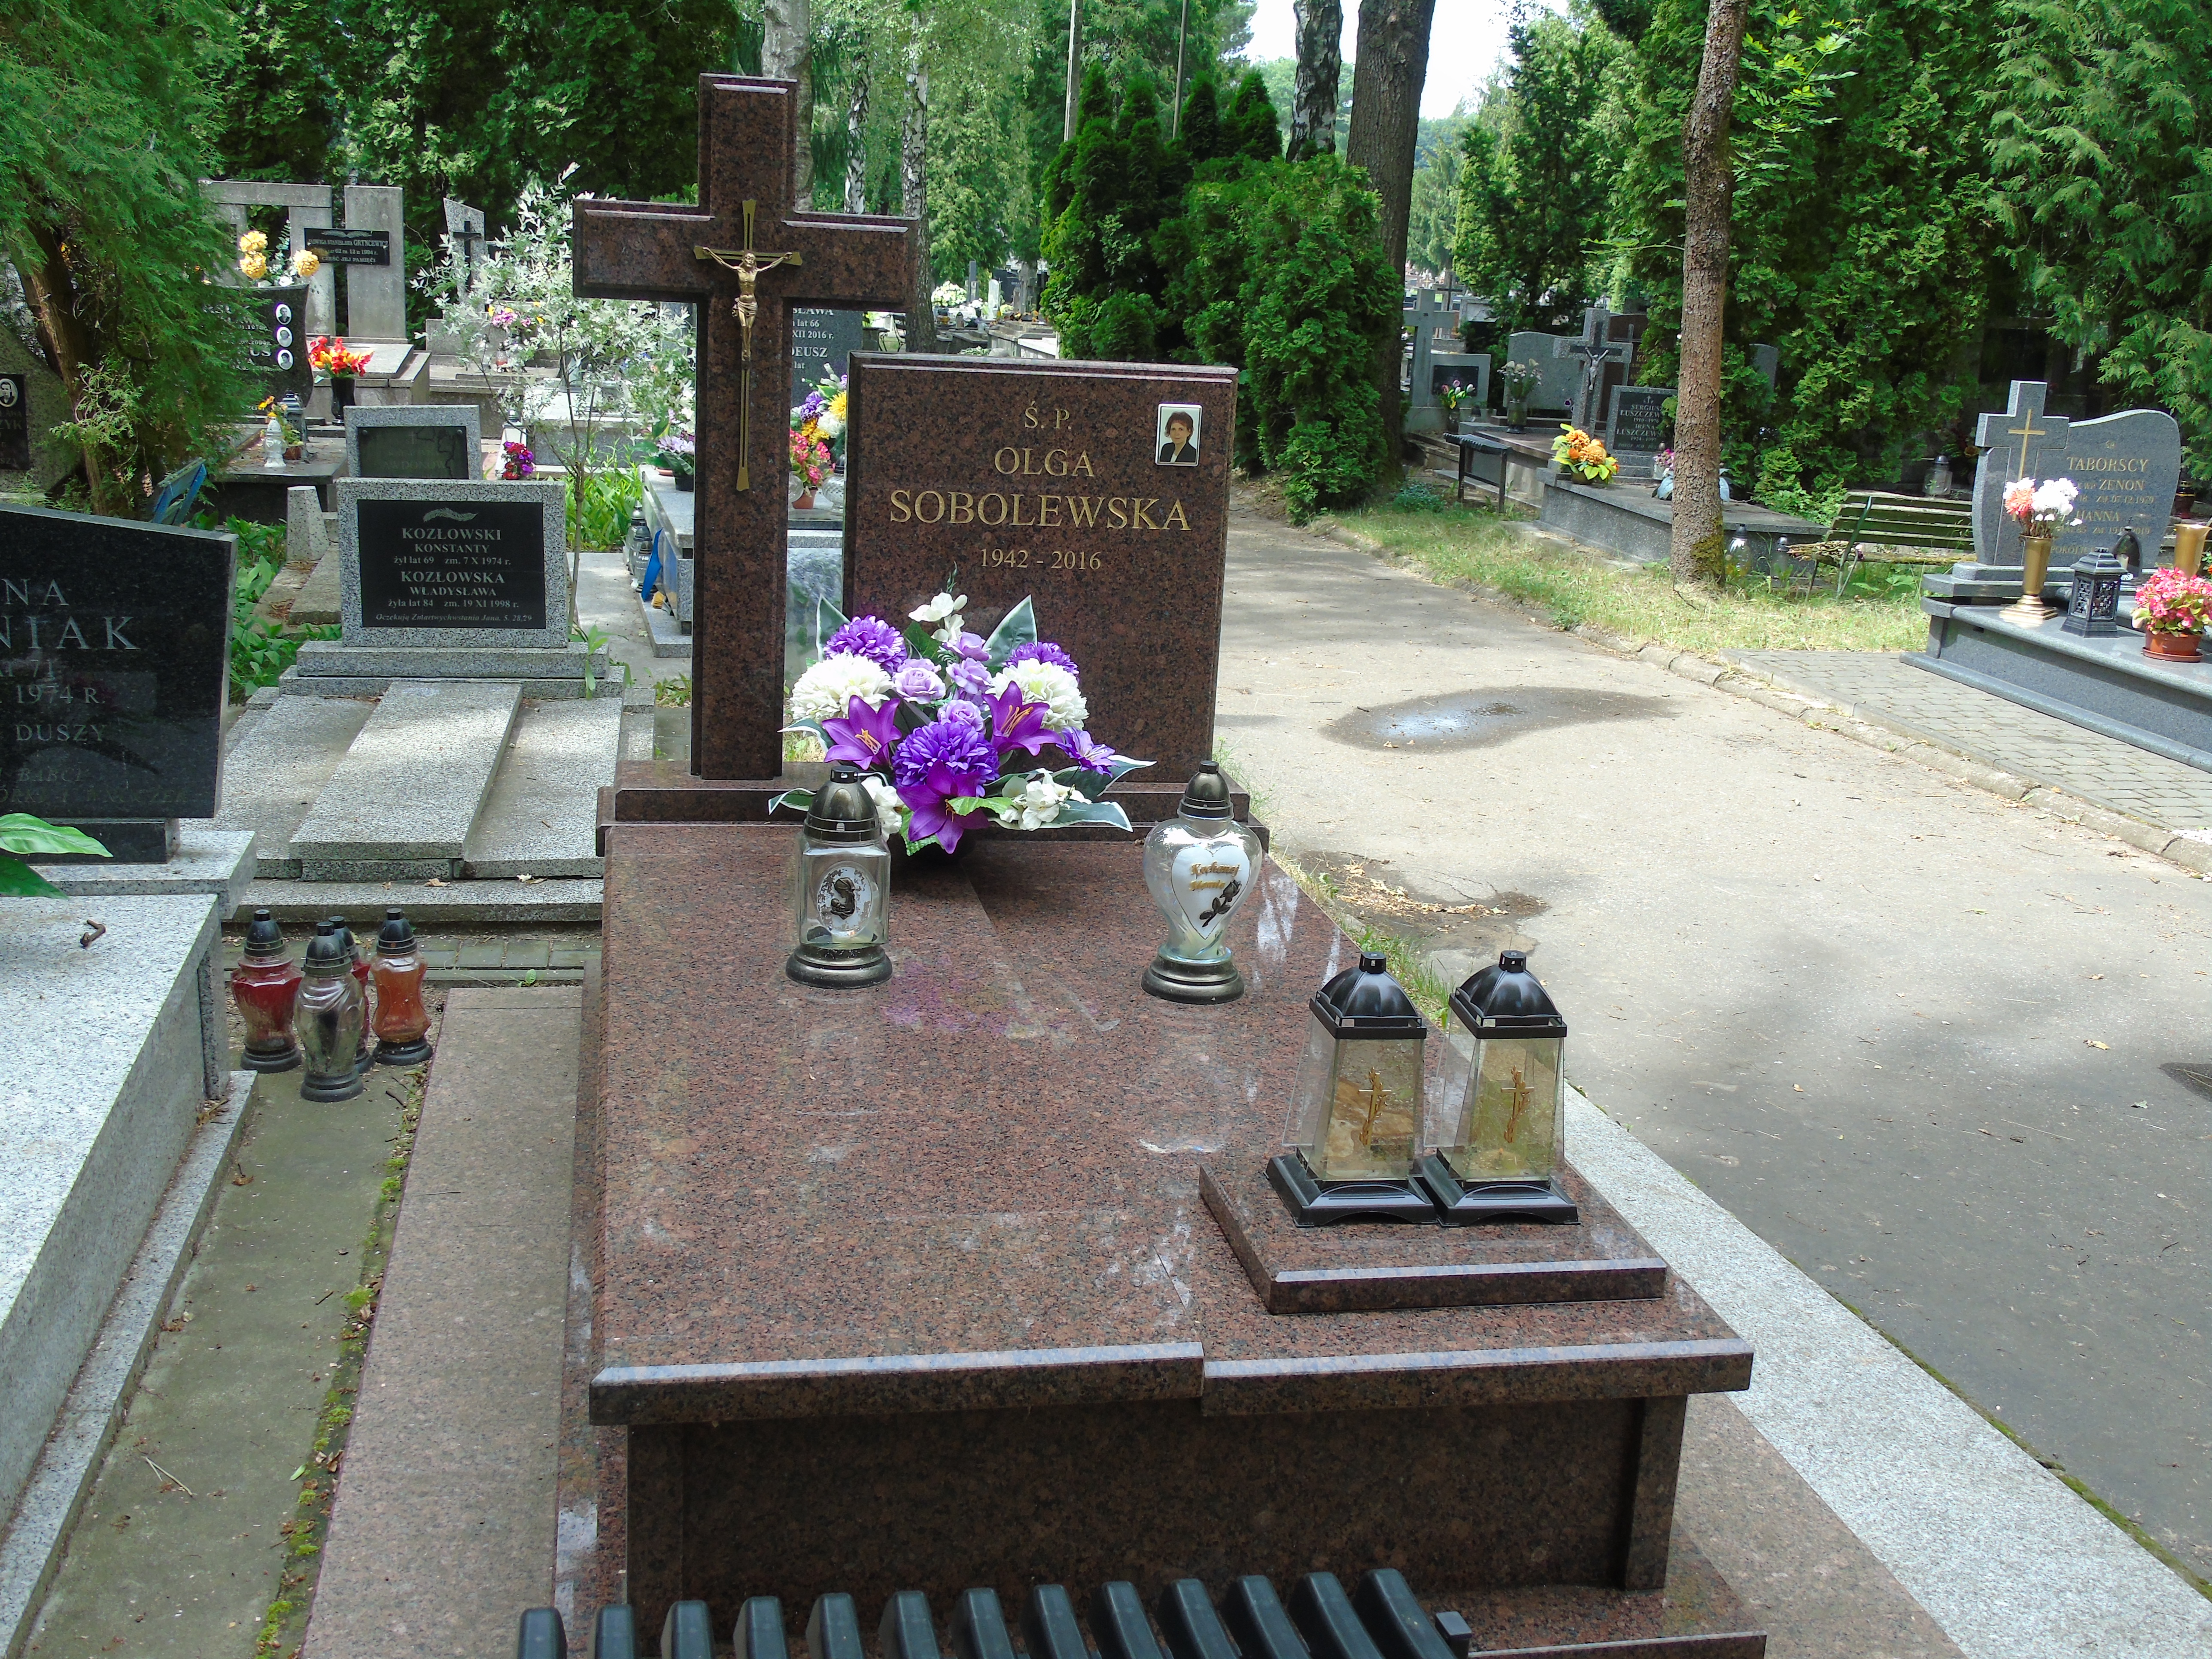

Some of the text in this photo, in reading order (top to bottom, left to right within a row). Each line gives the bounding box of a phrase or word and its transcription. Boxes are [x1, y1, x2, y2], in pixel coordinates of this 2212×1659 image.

[797, 319, 808, 327] lat
[1024, 401, 1072, 430] Ś. P.
[994, 447, 1095, 477] OLGA
[2066, 457, 2149, 472] TABORSCY
[2099, 479, 2145, 491] ZENON
[889, 489, 1192, 531] SOBOLEWSKA
[2076, 510, 2120, 522] HANNA
[402, 528, 501, 540] KOZŁOWSKI
[415, 544, 490, 553] KONSTANTY
[394, 556, 407, 565] żył
[980, 548, 1030, 568] 1942
[1051, 550, 1102, 570] 2016
[401, 571, 505, 583] KOZŁOWSKA
[409, 586, 497, 596] WŁADYSŁAWA
[388, 599, 406, 608] żyła
[376, 613, 410, 621] Oczekują
[30, 659, 55, 678] 71
[16, 684, 106, 704] 1974 R.
[16, 724, 107, 741] DUSZY
